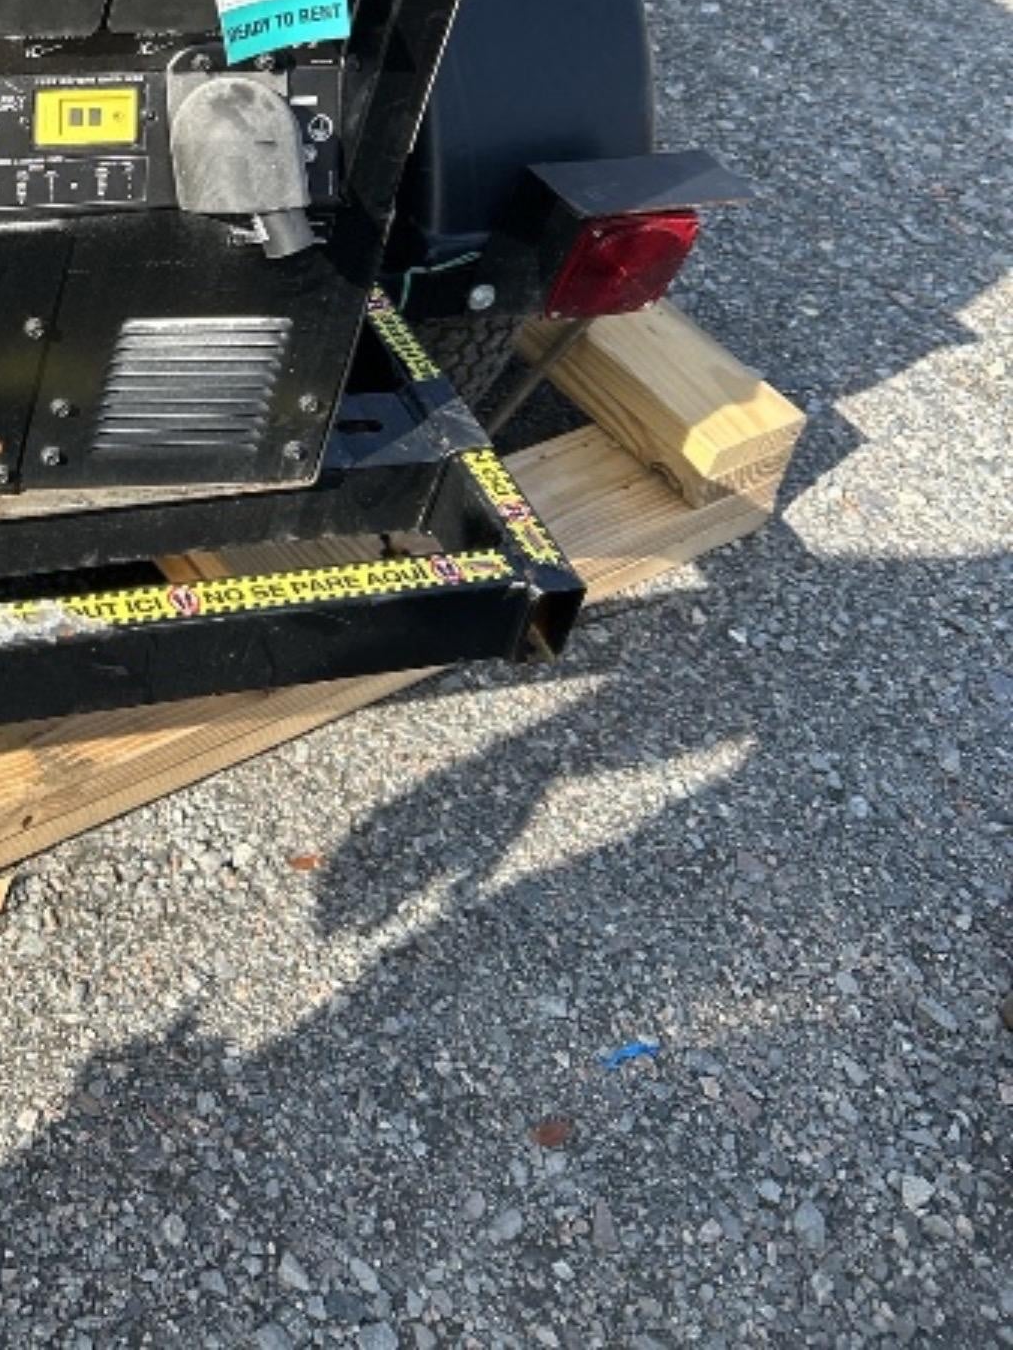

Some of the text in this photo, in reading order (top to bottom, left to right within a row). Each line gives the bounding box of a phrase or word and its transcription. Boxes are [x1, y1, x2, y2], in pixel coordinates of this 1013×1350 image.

[226, 2, 342, 44] READY TO RENT
[203, 586, 245, 604] NO
[251, 581, 285, 599] SE
[290, 575, 362, 595] PARE
[125, 597, 163, 614] ICI
